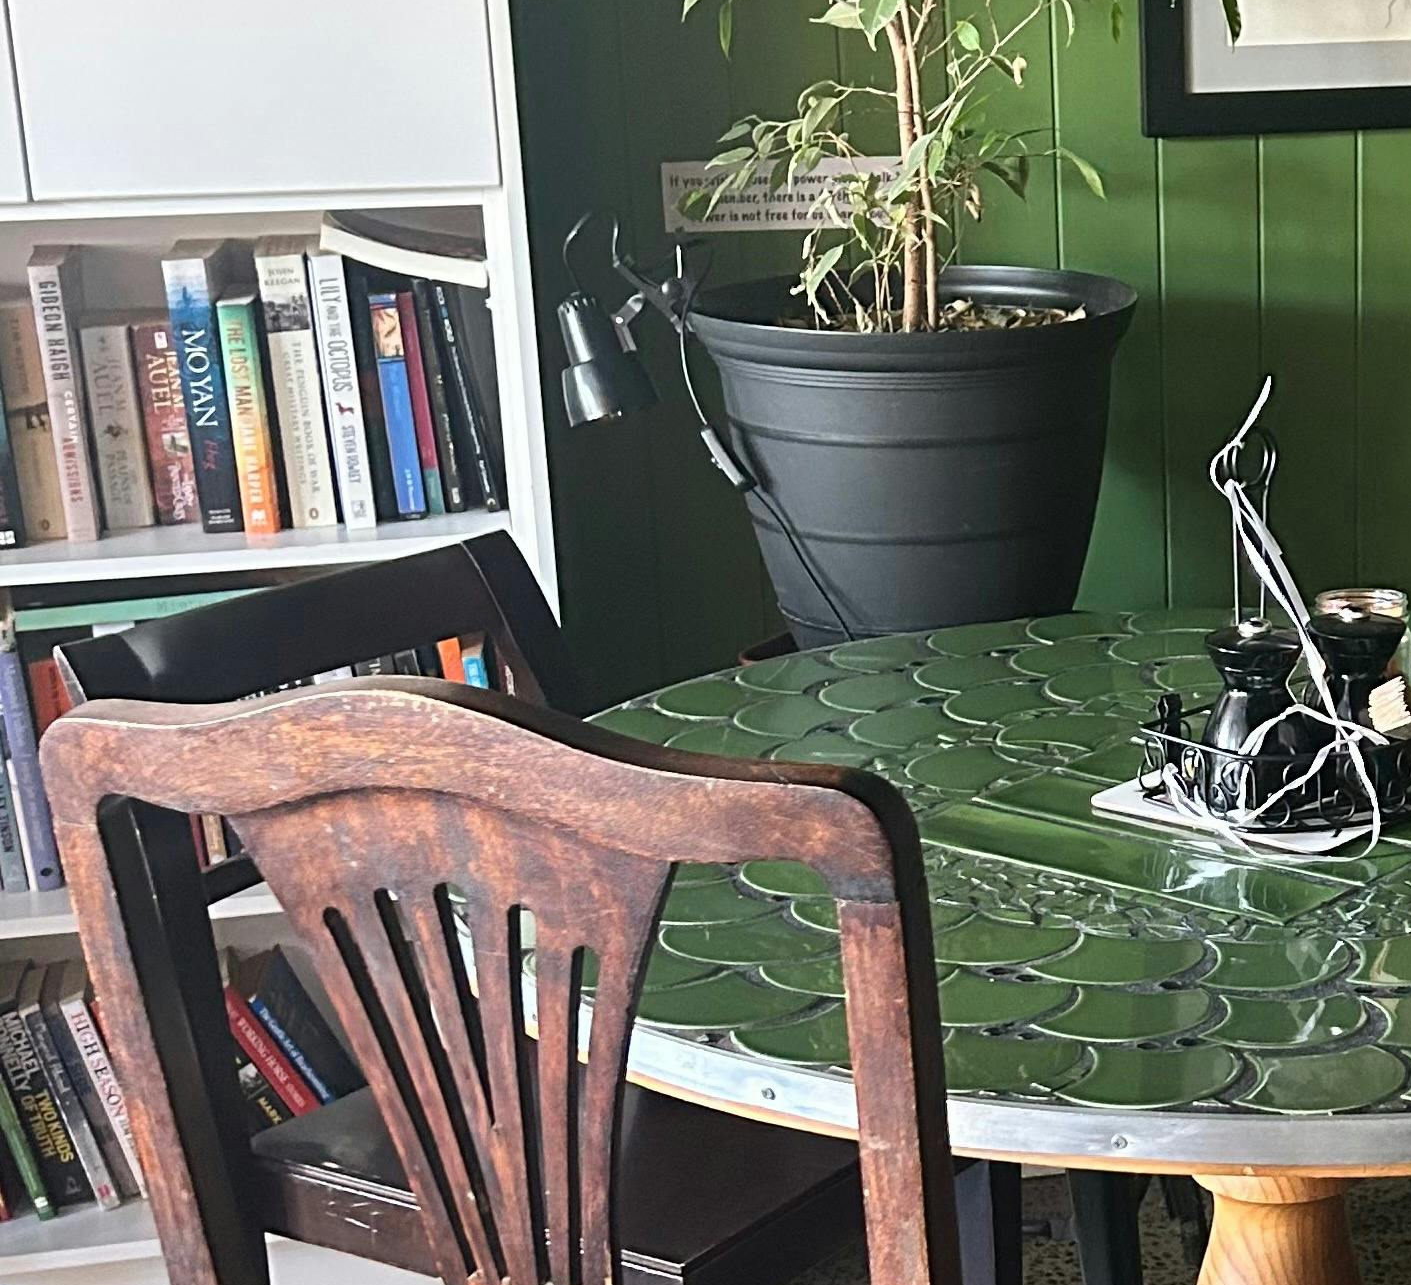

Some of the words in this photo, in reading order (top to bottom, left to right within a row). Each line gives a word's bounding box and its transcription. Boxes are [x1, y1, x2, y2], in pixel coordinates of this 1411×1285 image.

[793, 174, 828, 186] power
[796, 192, 806, 202] is
[729, 211, 740, 222] is
[742, 210, 762, 221] not
[765, 210, 788, 220] free
[265, 277, 301, 287] KEEGAN
[319, 277, 339, 304] LILY
[39, 281, 62, 333] GIDEON
[325, 304, 339, 322] AND
[225, 320, 245, 346] THE
[48, 337, 70, 381] HAIGH
[230, 348, 250, 382] LOST
[328, 338, 352, 392] OCTOPUS
[93, 360, 113, 414] AUEL
[147, 353, 173, 414] AUEL
[235, 384, 254, 416] MAN
[295, 368, 311, 417] PENGUIN
[64, 391, 80, 445] CERTAIN
[303, 420, 316, 452] BOOK
[309, 469, 321, 494] WAR
[2, 1012, 40, 1077] MICHAEL
[72, 1012, 100, 1056] HIGH
[89, 1057, 124, 1118] SEASON
[21, 1096, 37, 1112] OF
[29, 1114, 54, 1157] TRUTH
[35, 1089, 57, 1122] TWO
[47, 1120, 74, 1162] KINDS
